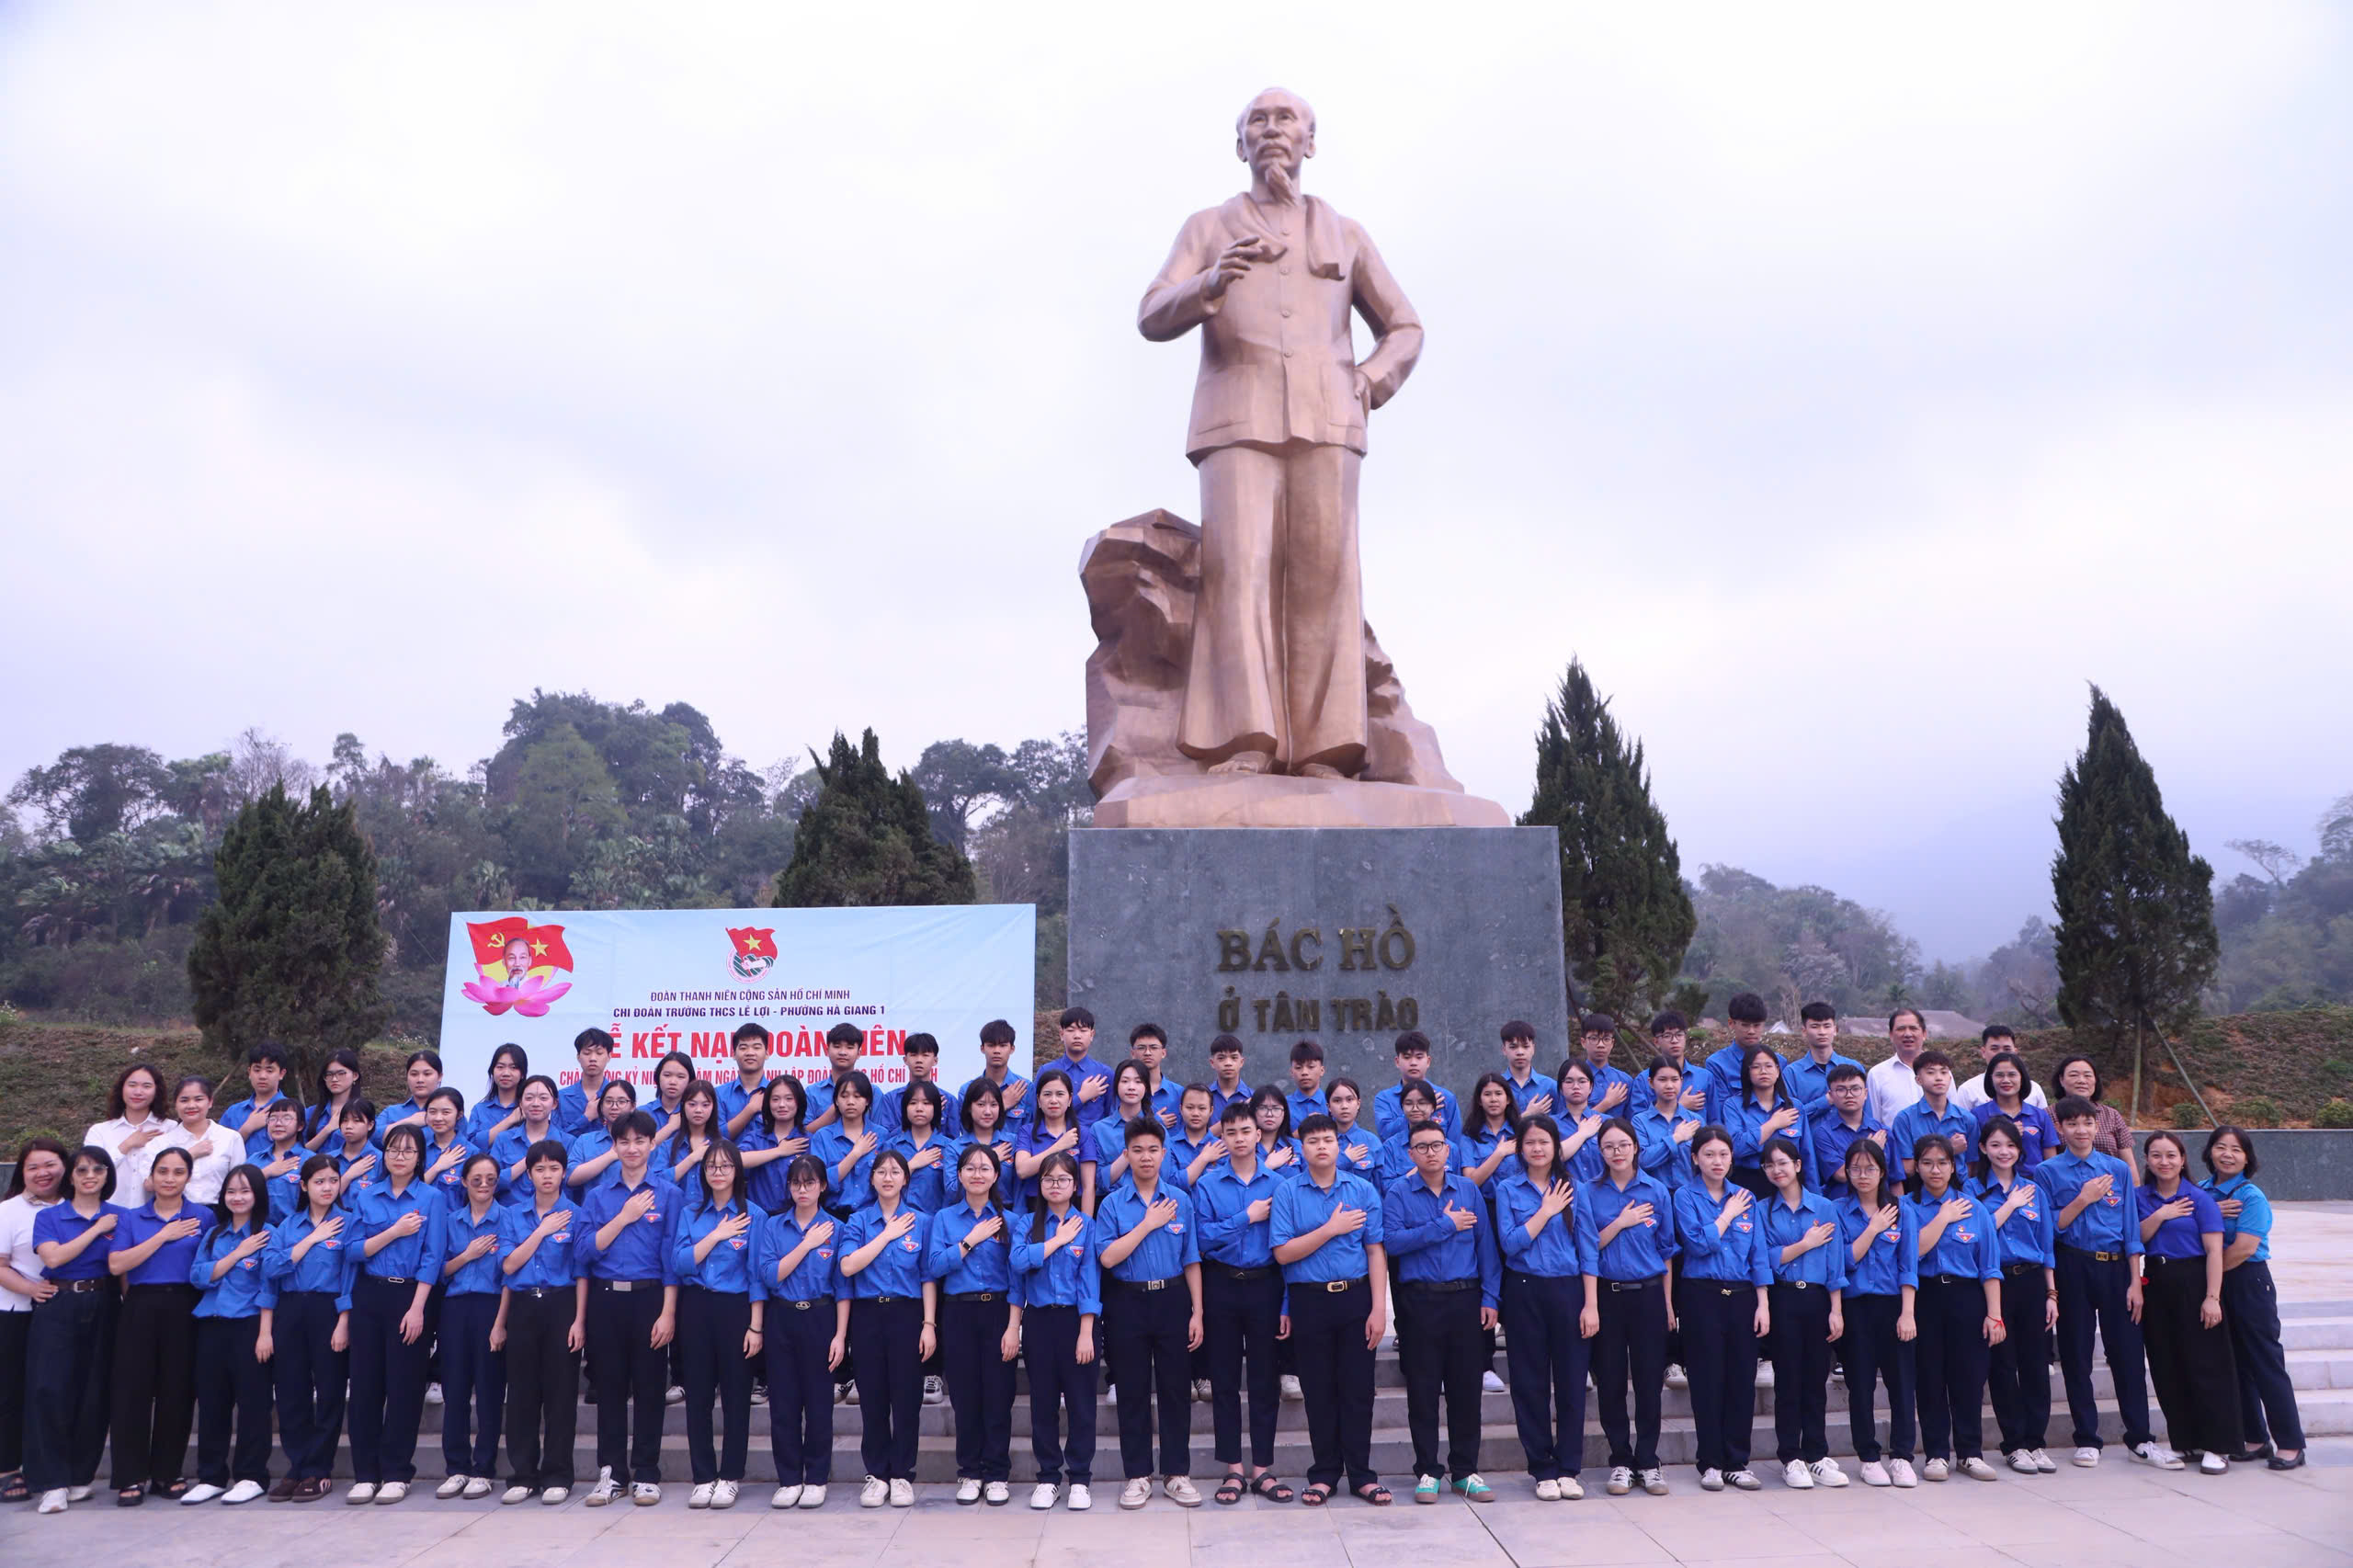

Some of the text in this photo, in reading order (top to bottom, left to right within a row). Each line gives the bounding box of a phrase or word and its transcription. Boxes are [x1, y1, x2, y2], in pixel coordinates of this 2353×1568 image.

[1216, 903, 1415, 971] BÁC HỒ
[651, 987, 850, 1003] ĐOÀN THANH NIÊN CỘNG SẢN HỒ CHÍ MINH
[1219, 985, 1419, 1032] Ở TÂN TRÀO
[613, 1007, 631, 1017] CHI
[634, 1006, 662, 1017] ĐOÀN
[665, 1006, 706, 1017] TRƯỜNG
[710, 1007, 735, 1017] THCS
[739, 1006, 750, 1017] LÊ
[754, 1006, 769, 1018] LỢI
[780, 1005, 824, 1016] PHƯỜNG
[827, 1005, 840, 1016] HÀ
[844, 1006, 876, 1016] GIANG
[881, 1006, 885, 1015] 1
[631, 1024, 682, 1058] KẾT
[860, 1024, 905, 1056] IÊN
[559, 1068, 583, 1085] CHÀ
[625, 1066, 639, 1085] KỶ
[696, 1067, 712, 1083] ĂM
[715, 1067, 738, 1085] NGÀ
[870, 1063, 885, 1084] HỒ
[888, 1065, 905, 1084] CHÍ
